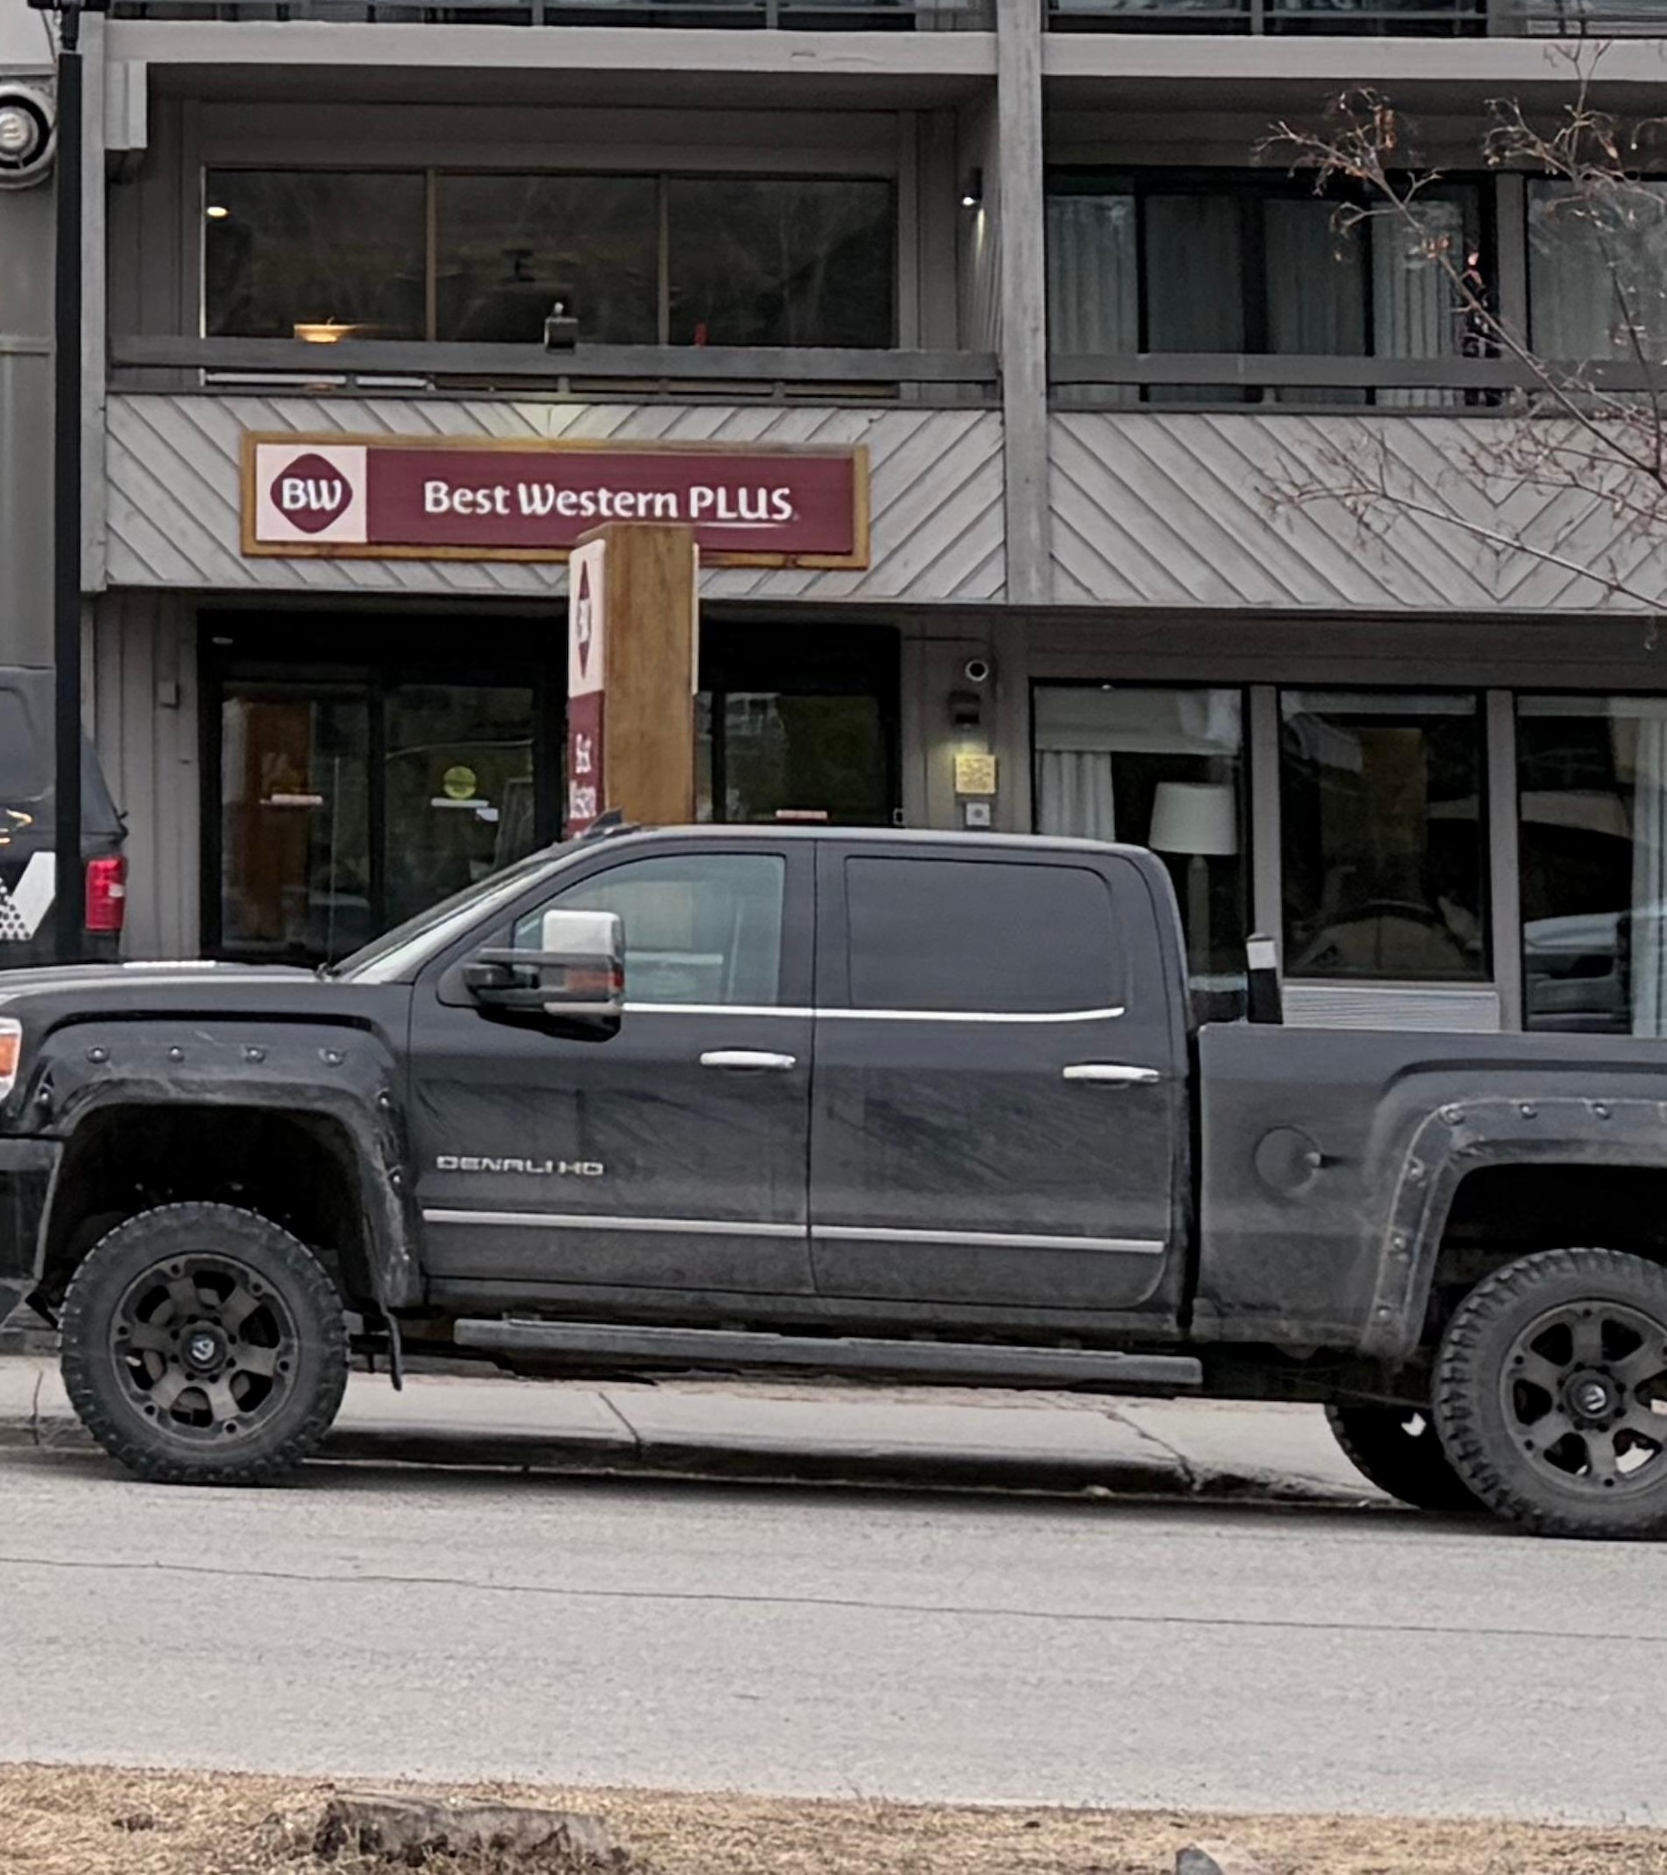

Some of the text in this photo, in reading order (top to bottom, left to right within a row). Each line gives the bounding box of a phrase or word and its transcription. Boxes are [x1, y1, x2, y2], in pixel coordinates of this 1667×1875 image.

[282, 477, 343, 511] BW
[424, 480, 792, 521] Best Western PLUS
[436, 1155, 553, 1173] DENALI
